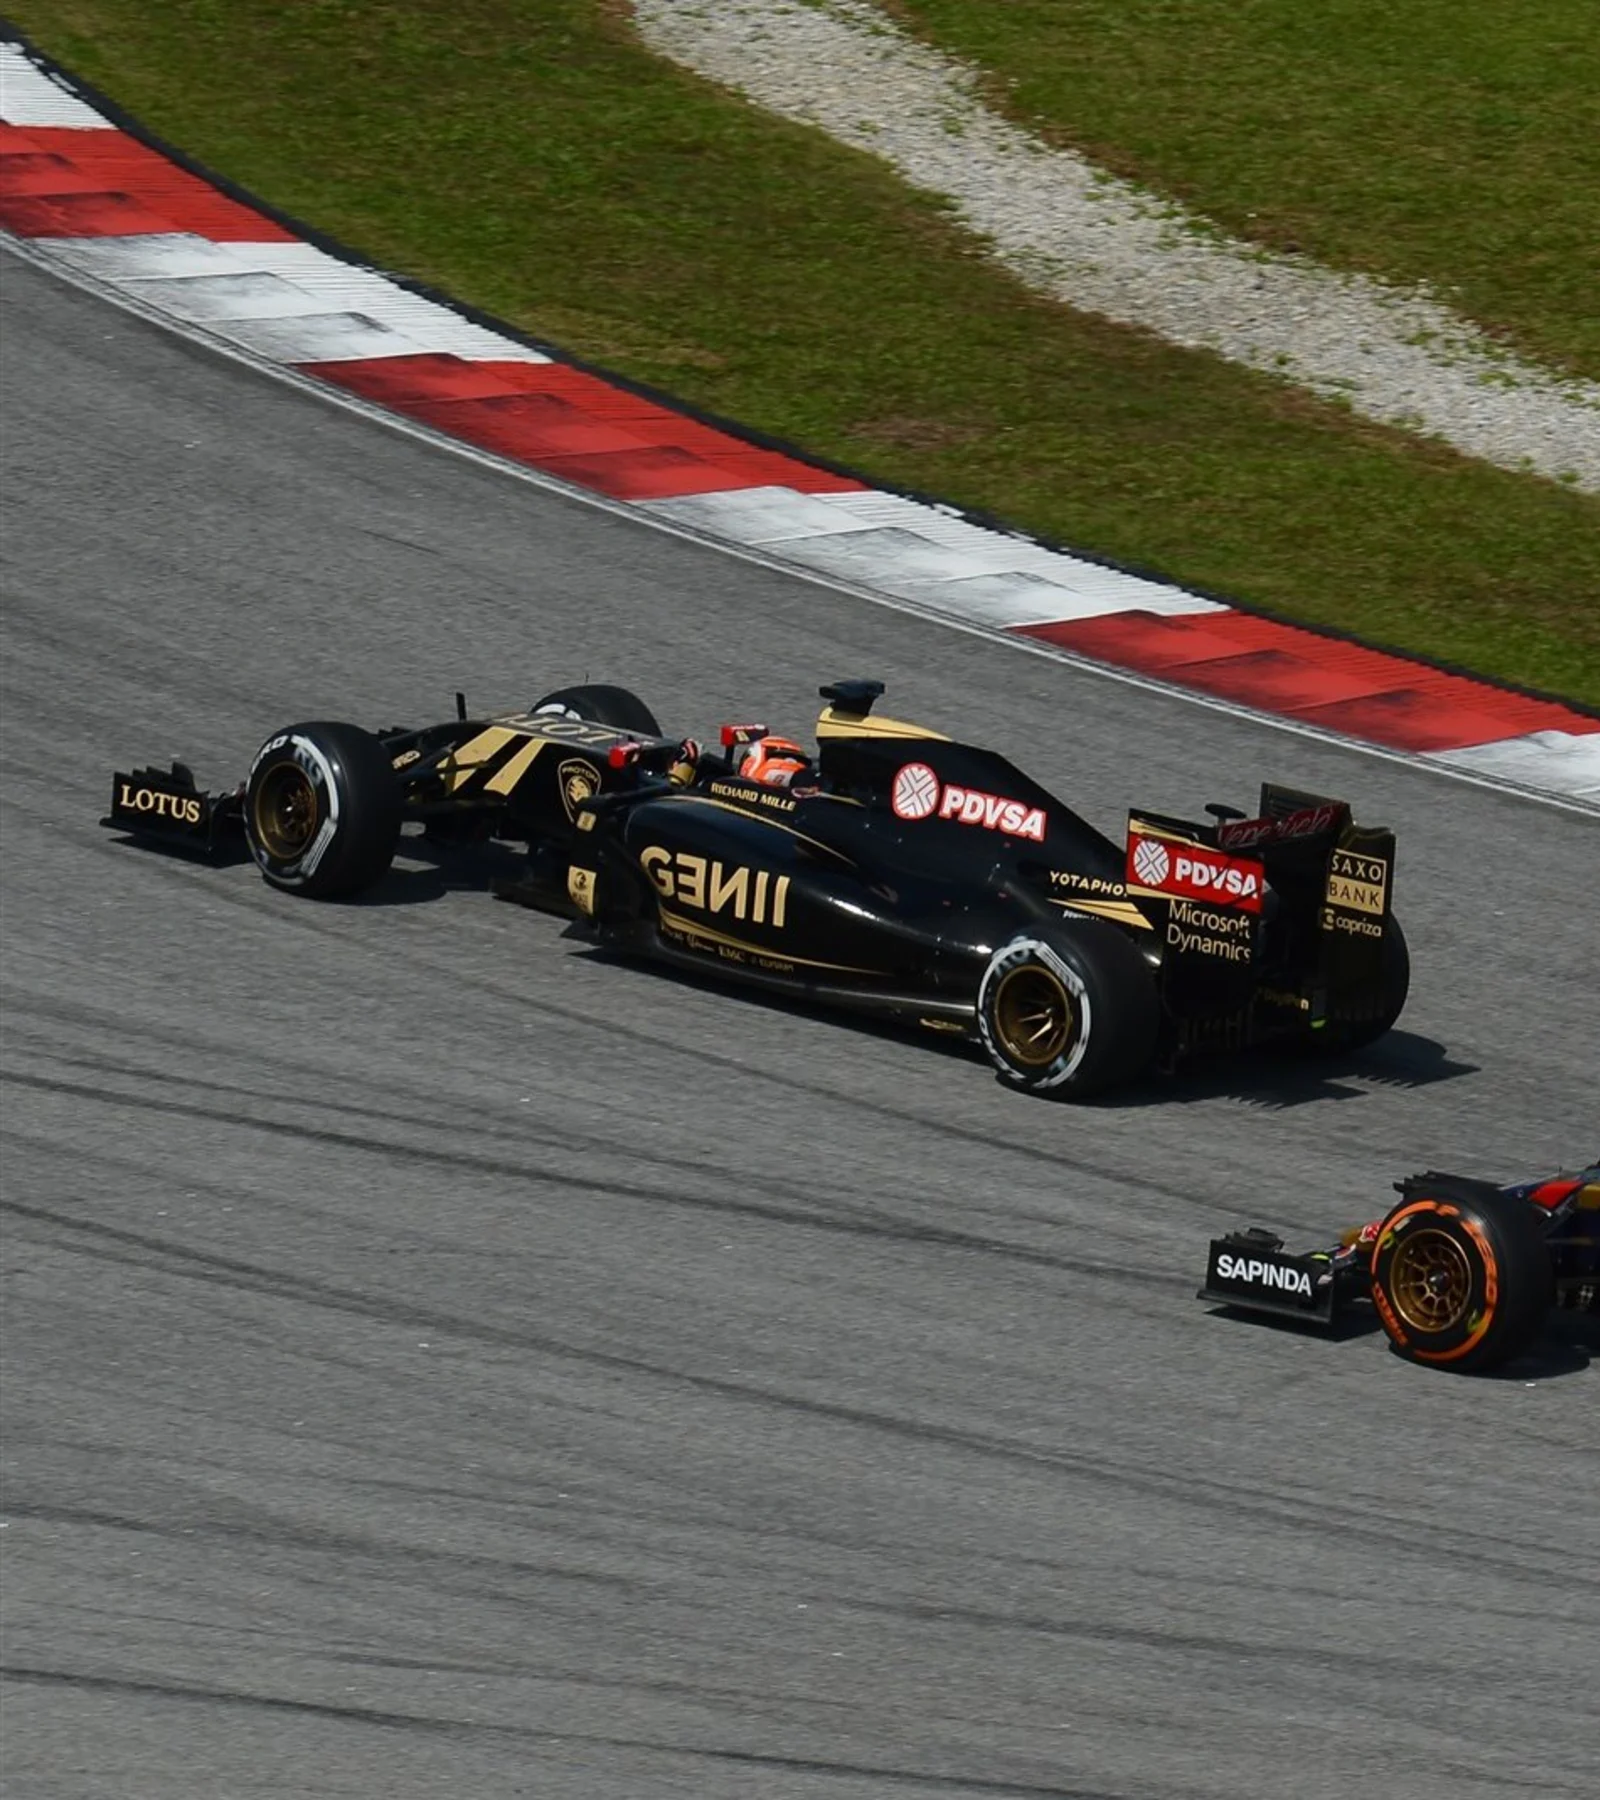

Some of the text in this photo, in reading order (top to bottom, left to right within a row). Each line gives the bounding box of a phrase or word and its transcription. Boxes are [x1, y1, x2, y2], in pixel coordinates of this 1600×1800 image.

[561, 765, 599, 783] PROTON
[120, 784, 200, 823] LOTUS
[710, 782, 796, 811] RICHARD MILLE
[939, 784, 1047, 842] PDVSA
[1049, 871, 1128, 897] YOTAPHO
[1175, 857, 1258, 898] PDVSA
[1331, 854, 1382, 881] SAXO
[1329, 881, 1381, 908] BANK
[1168, 899, 1251, 939] Microsoft
[1336, 916, 1383, 938] capriza
[1166, 923, 1251, 963] Dynamics
[1216, 1254, 1312, 1297] SAPINDA
